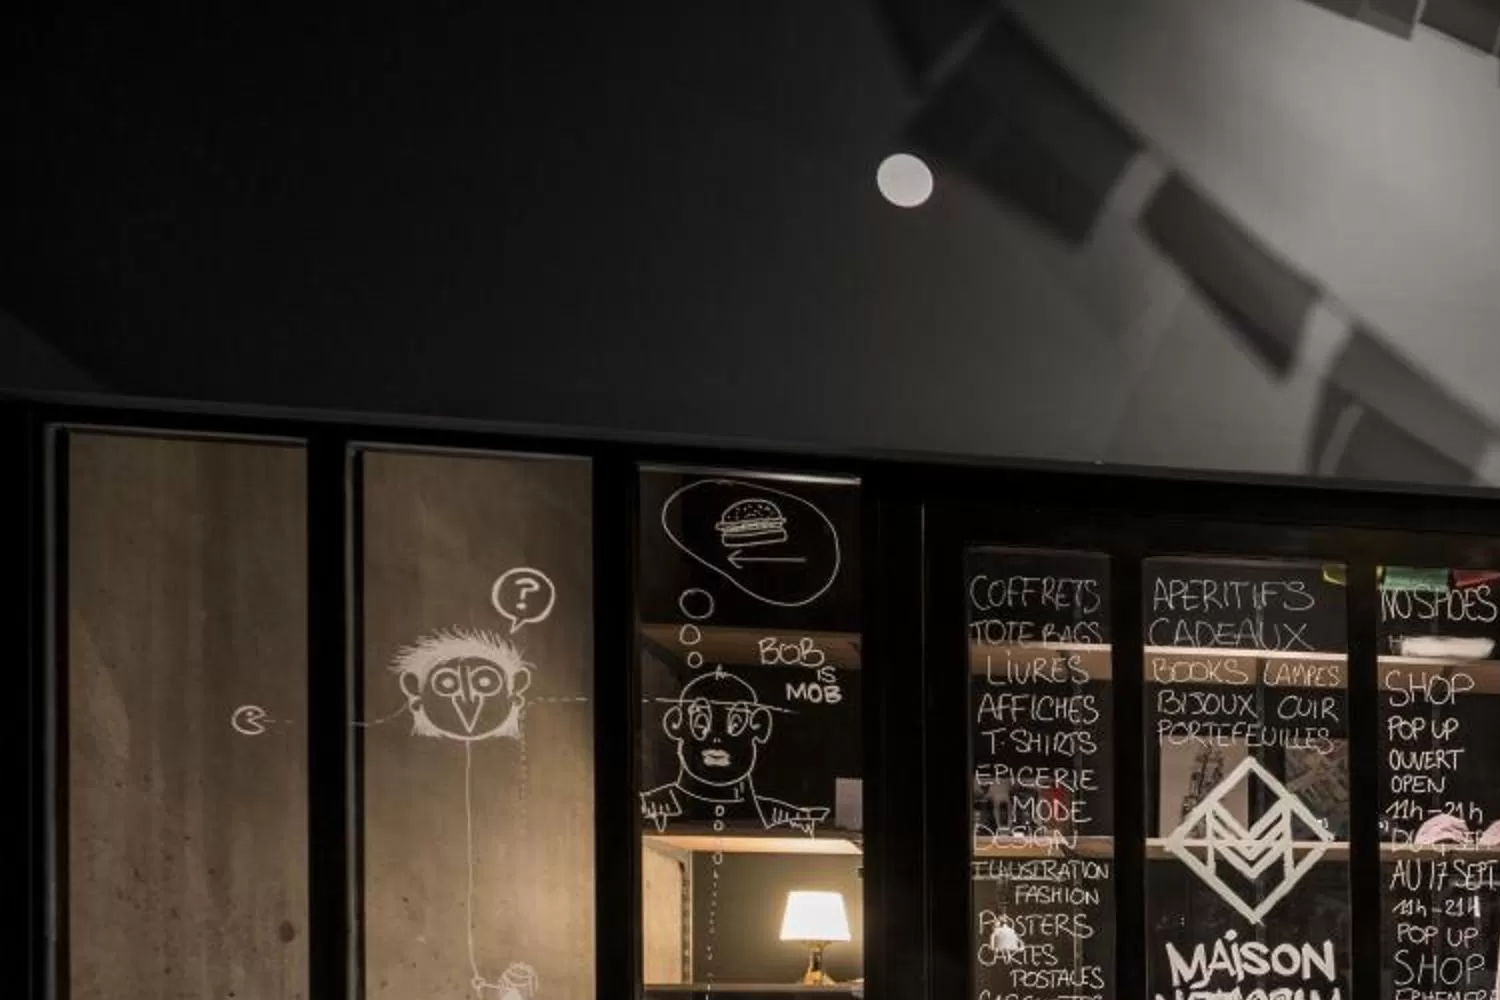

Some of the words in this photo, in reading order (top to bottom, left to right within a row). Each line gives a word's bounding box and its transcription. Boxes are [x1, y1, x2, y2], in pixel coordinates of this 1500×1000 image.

[969, 574, 1101, 614] COFFRETS
[1153, 576, 1316, 613] APERITIFS
[968, 618, 1035, 648] TOTE
[1042, 620, 1103, 654] BAGS
[1149, 615, 1316, 653] CADEAUX
[758, 637, 825, 667] BOB
[816, 665, 837, 682] IS
[1151, 656, 1250, 685] BOOKS
[1263, 657, 1342, 687] LAMPES
[785, 683, 842, 703] MOB
[1385, 669, 1475, 708] SHOP
[976, 692, 1100, 724] AFFICHES
[1156, 688, 1260, 719] BIJOUX
[1276, 694, 1341, 723] CUIR
[1387, 714, 1425, 742] POP
[1430, 716, 1460, 741] UP
[1388, 747, 1466, 771] OUVERT
[975, 763, 1098, 793] EPICERIE
[1391, 775, 1446, 795] OPEN
[1012, 795, 1093, 824] MODE
[974, 822, 1078, 857] DESIGN
[970, 858, 1110, 883] ILLUSTRATION
[1388, 859, 1422, 892] AU
[1452, 859, 1500, 892] SEPT
[1014, 884, 1100, 905] FASHION
[978, 910, 1093, 939] POSTERS
[1397, 922, 1440, 946] POP
[1446, 926, 1480, 950] UP
[976, 940, 1059, 967] CARTES
[1164, 928, 1337, 990] MAISON
[1393, 948, 1486, 987] SHOP
